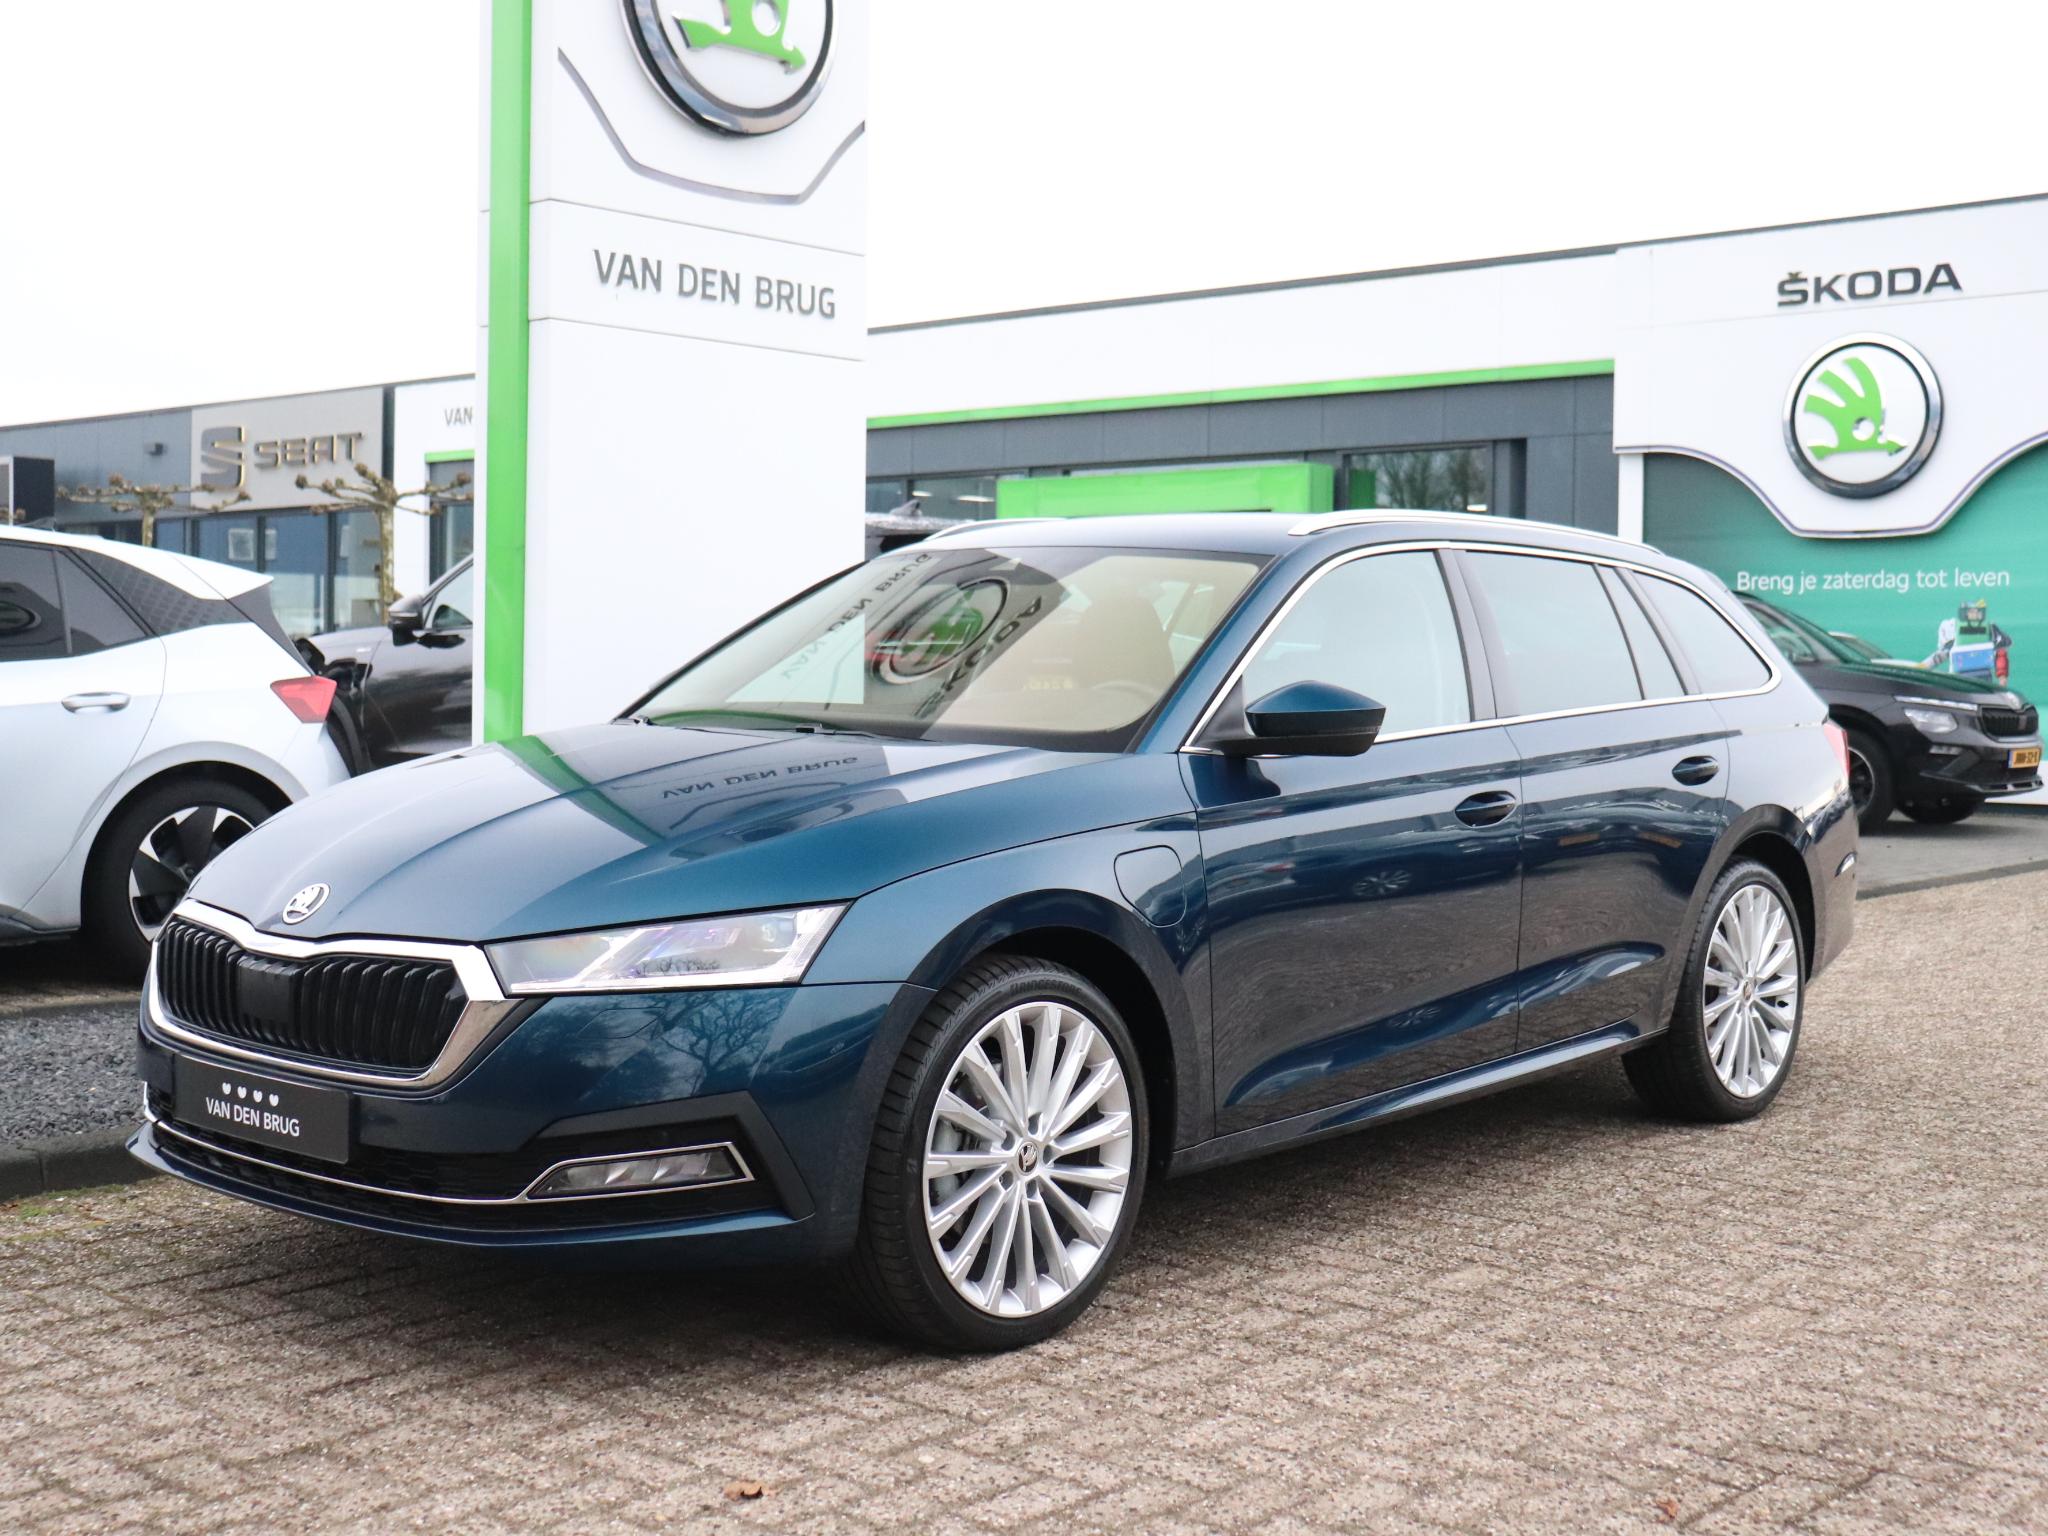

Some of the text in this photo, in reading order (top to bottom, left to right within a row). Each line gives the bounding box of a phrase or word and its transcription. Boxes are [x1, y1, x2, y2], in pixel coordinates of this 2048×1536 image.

[594, 249, 836, 319] VAN DEN BRUG
[1777, 263, 1963, 308] ŠKODA
[444, 406, 473, 426] VAN
[254, 432, 365, 470] SEAT
[1737, 567, 2010, 594] Breng je zaterdag tot leven
[206, 1096, 300, 1137] VAN DEN BRUG
